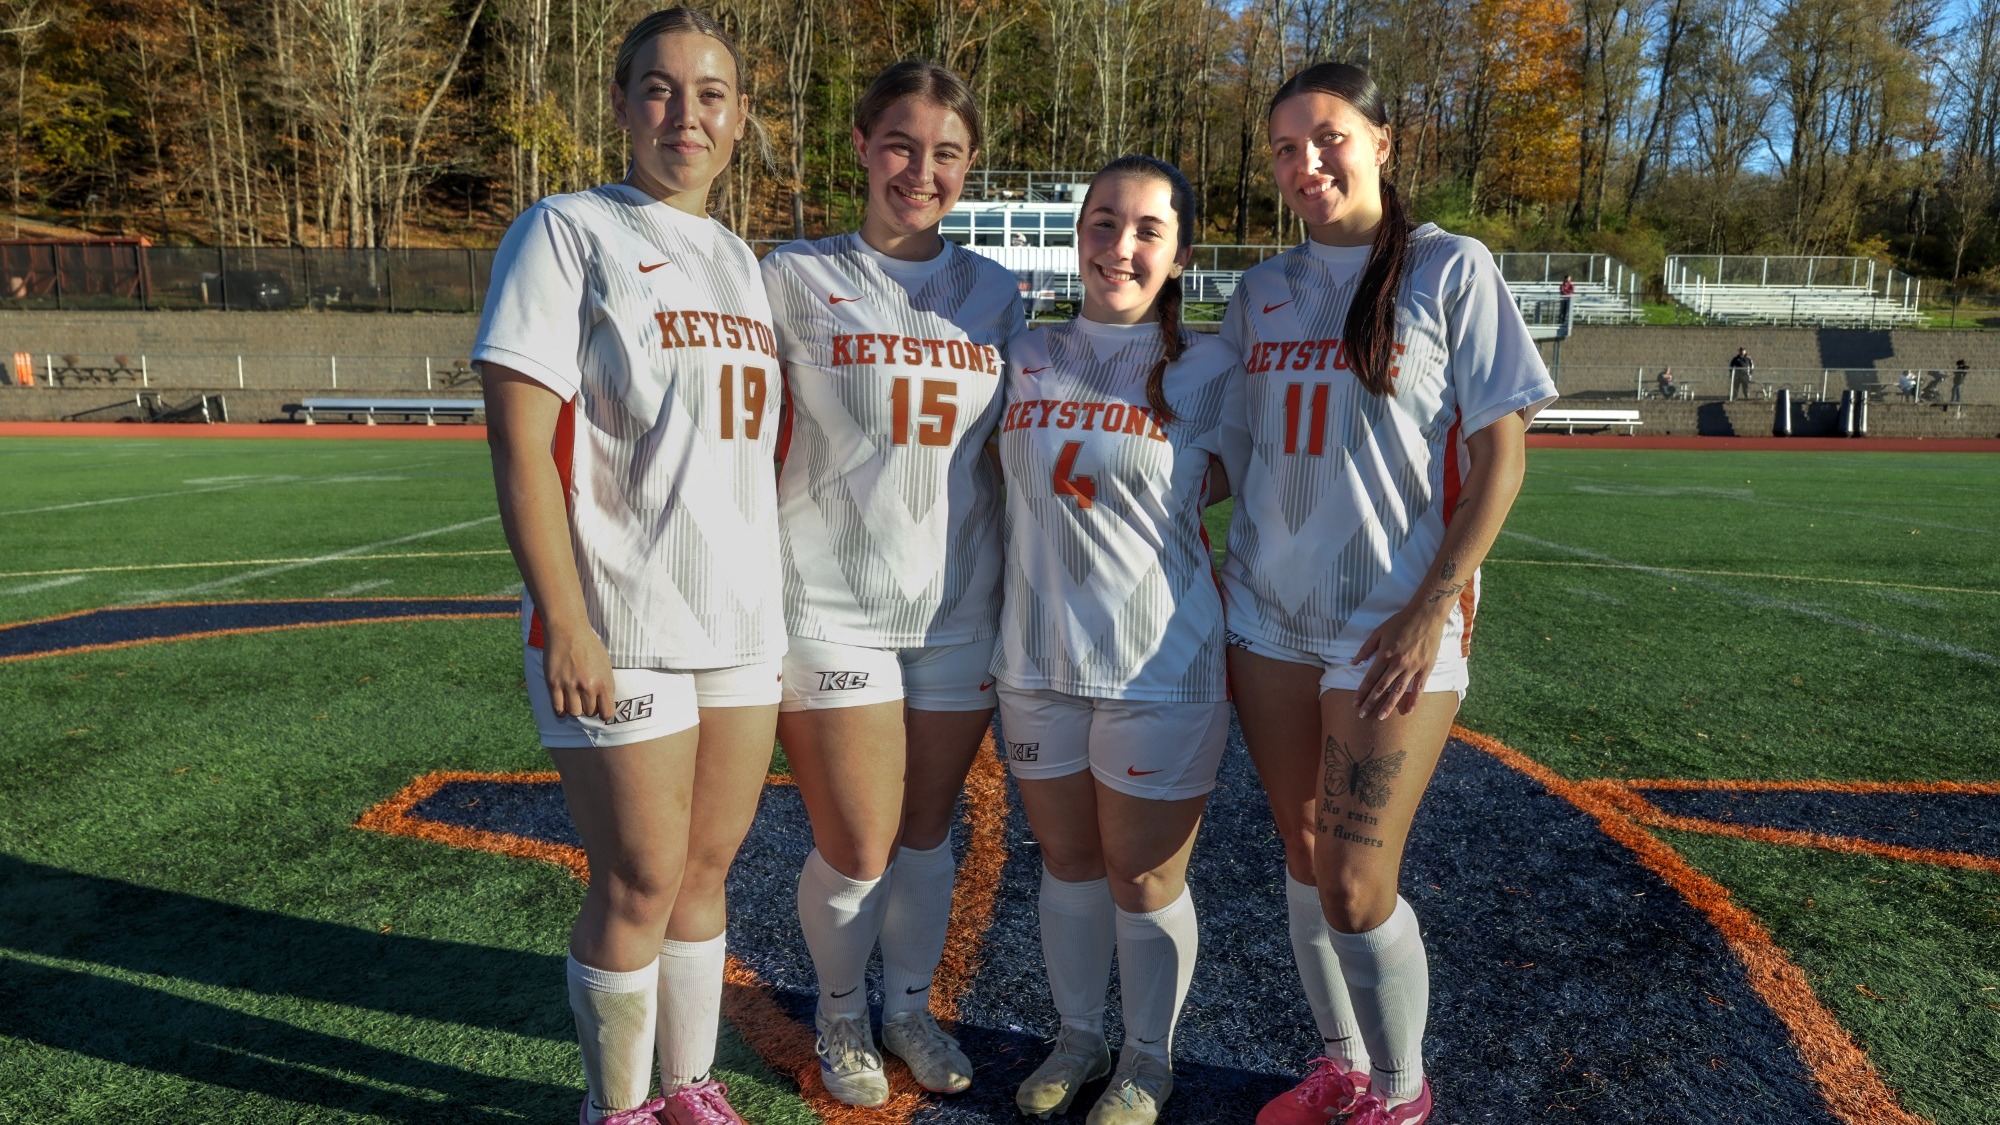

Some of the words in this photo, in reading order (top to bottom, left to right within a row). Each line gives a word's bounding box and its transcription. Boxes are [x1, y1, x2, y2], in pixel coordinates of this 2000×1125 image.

[832, 332, 998, 376] KEYSTONE
[719, 363, 767, 441] 19
[889, 376, 959, 448] 15
[1003, 399, 1172, 443] KEYSTONE
[1283, 381, 1332, 458] 11
[1052, 439, 1099, 510] 4
[815, 671, 869, 691] KC
[1008, 741, 1039, 761] KC
[1321, 798, 1340, 815] No
[1347, 811, 1378, 826] rain
[1333, 824, 1384, 848] flowers
